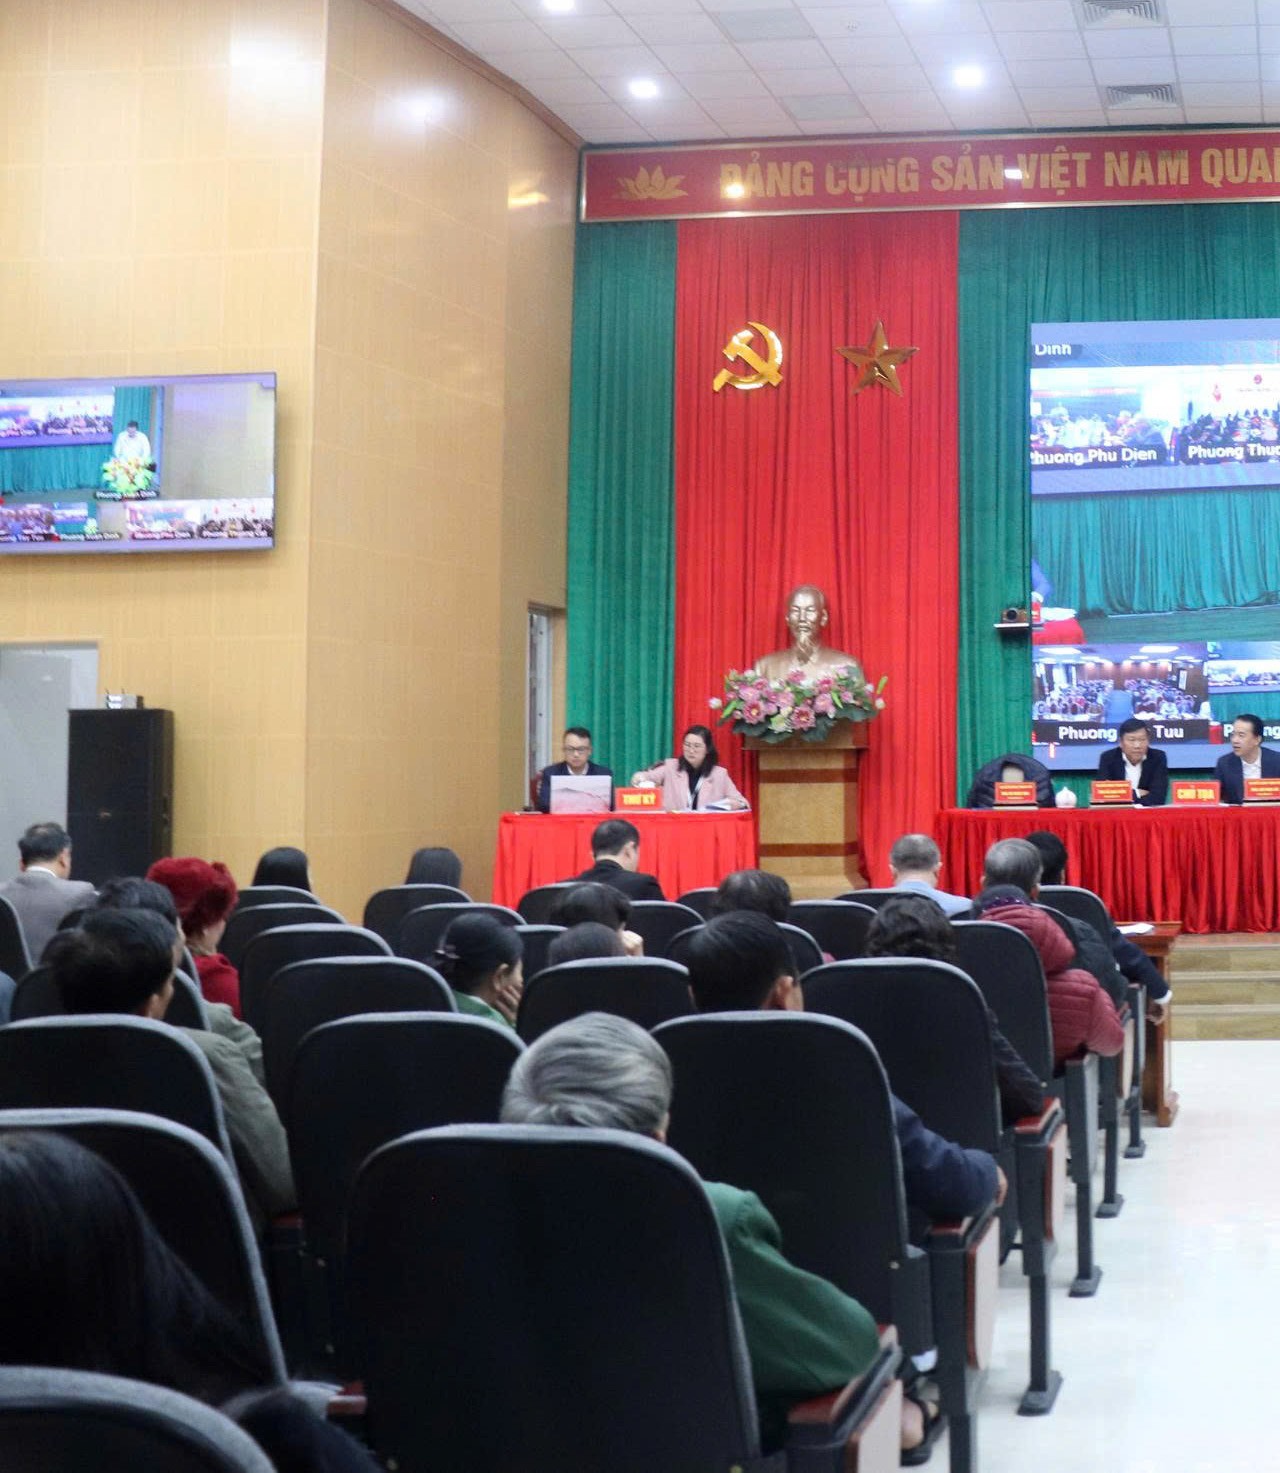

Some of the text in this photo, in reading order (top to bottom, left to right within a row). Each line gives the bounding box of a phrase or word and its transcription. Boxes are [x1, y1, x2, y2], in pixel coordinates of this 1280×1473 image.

[720, 151, 814, 199] ĐẢNG
[825, 151, 919, 202] CỘNG
[931, 143, 1004, 191] SẢN
[1017, 145, 1091, 196] VIỆT
[1104, 150, 1189, 187] NAM
[1087, 448, 1117, 462] Phu
[1122, 447, 1157, 461] Dien
[1188, 445, 1243, 460] Phuong
[1058, 725, 1184, 742] Phuong Tuu
